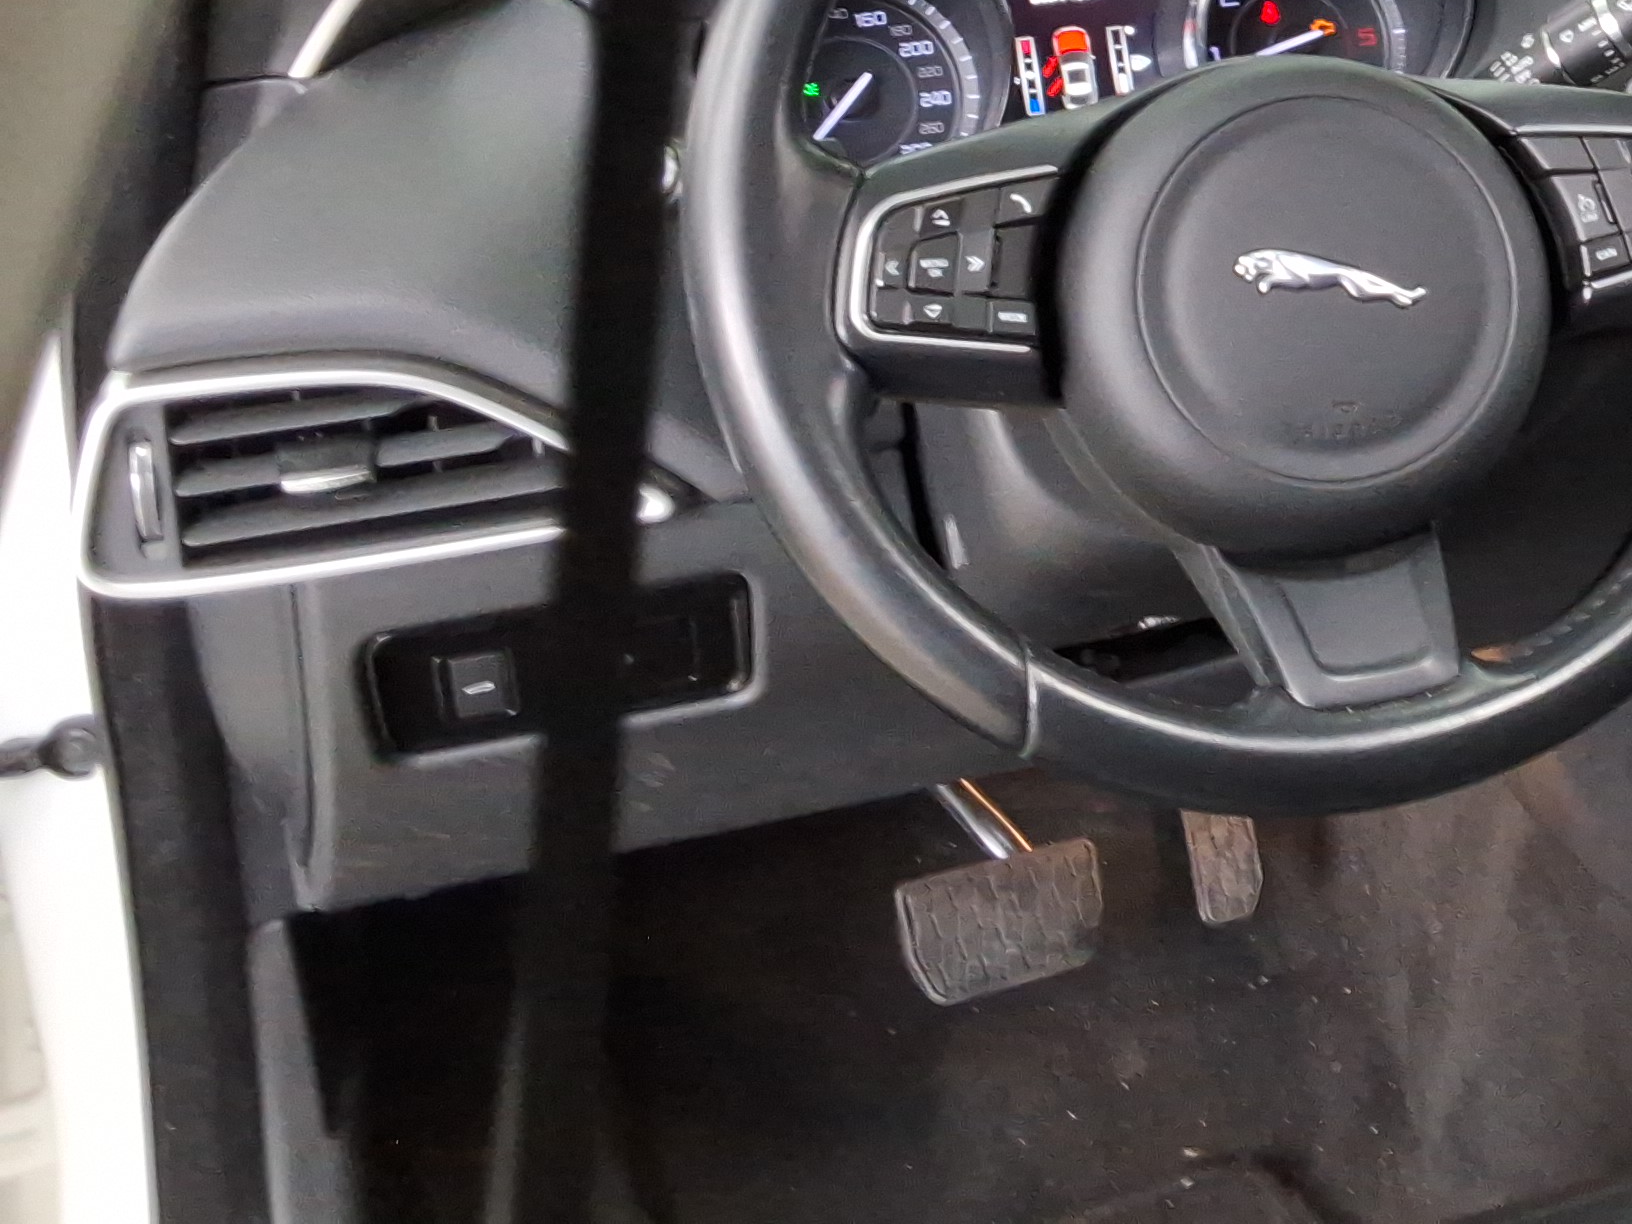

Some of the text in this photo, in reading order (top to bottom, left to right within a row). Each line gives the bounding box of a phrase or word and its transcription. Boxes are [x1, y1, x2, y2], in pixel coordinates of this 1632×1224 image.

[855, 11, 888, 28] 160
[1358, 28, 1377, 46] 5
[899, 40, 934, 57] 200
[1209, 46, 1222, 62] 1
[919, 90, 952, 108] 240
